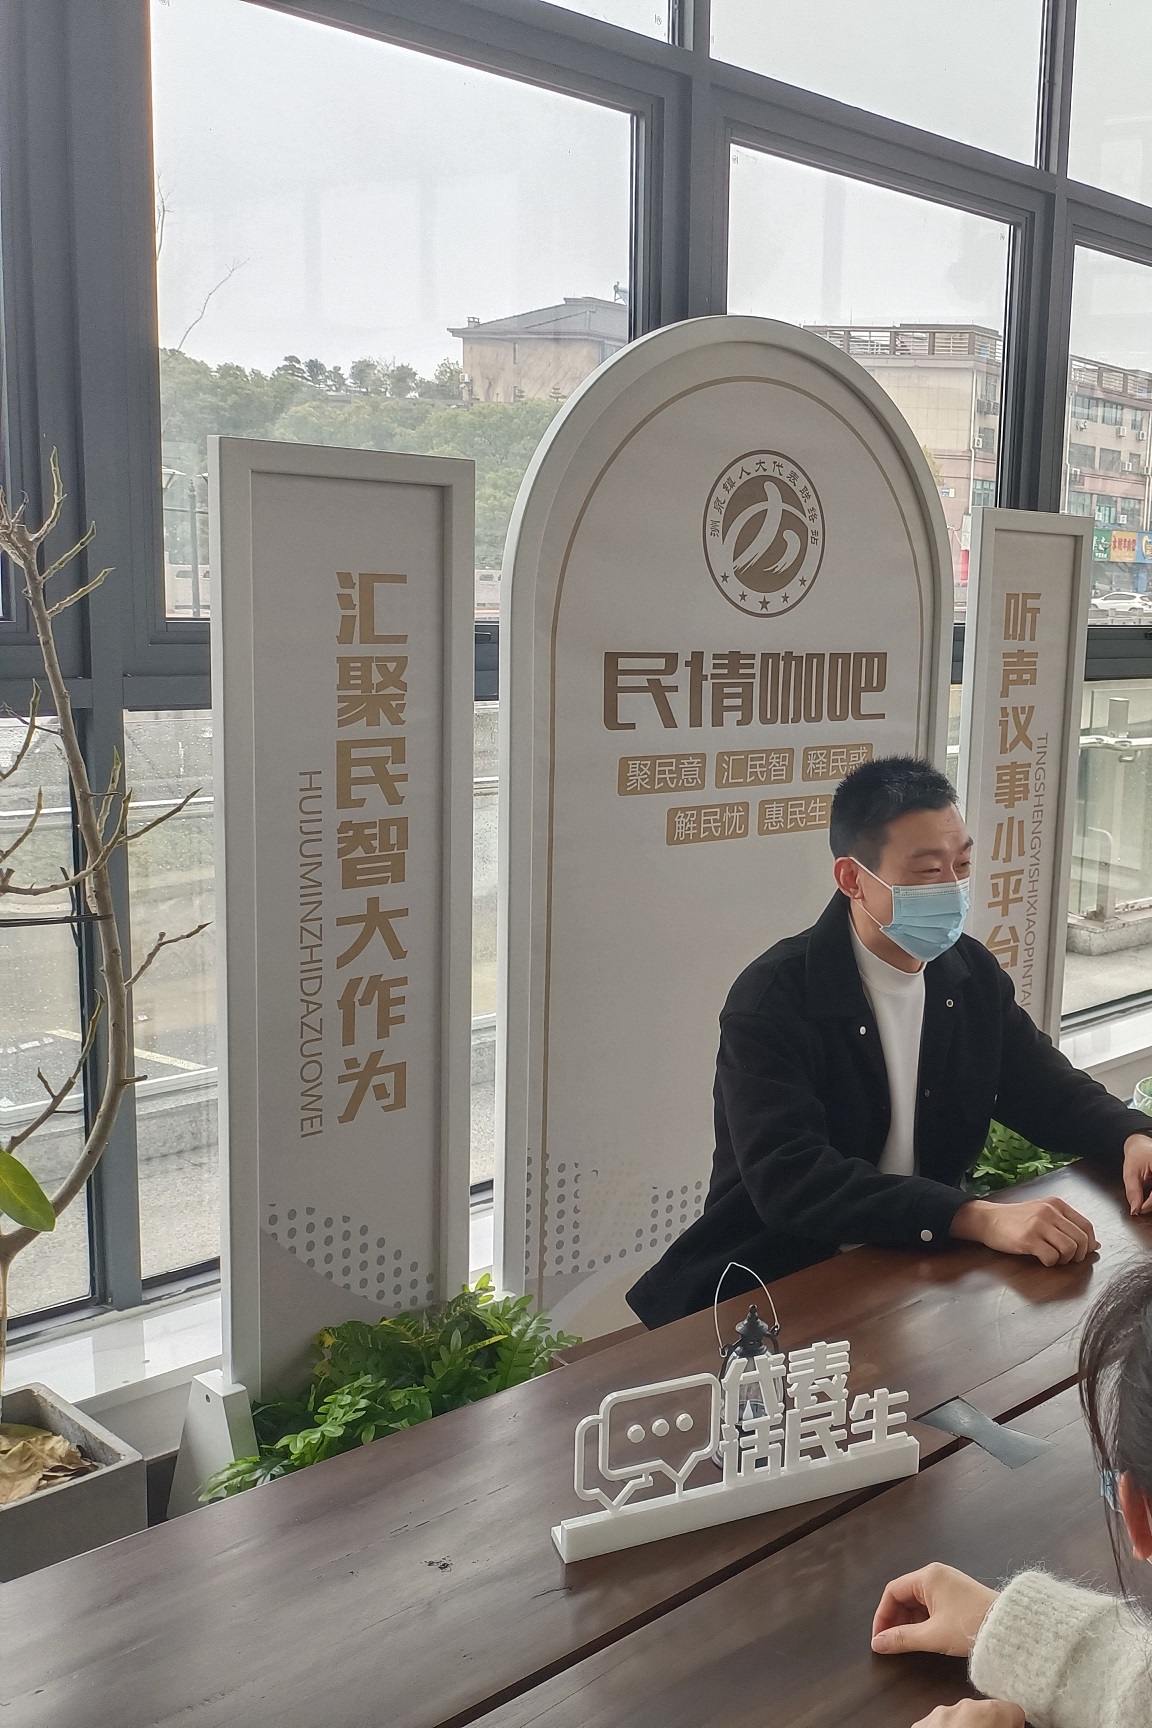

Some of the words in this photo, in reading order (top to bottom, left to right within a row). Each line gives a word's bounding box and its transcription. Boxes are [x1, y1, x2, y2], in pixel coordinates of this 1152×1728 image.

[709, 459, 820, 546] 洲泉镇人大代表联络站
[603, 650, 888, 731] 民情咖吧
[625, 756, 703, 792] 聚民意
[722, 751, 789, 786] 汇民智
[985, 592, 1042, 968] 听声议事小平台
[336, 571, 409, 1124] 汇聚民智大作为
[673, 805, 745, 842] 解民忧
[763, 798, 828, 831] 惠民生
[298, 770, 323, 1138] HUIJUMINZHIDAZUOWEI
[721, 1341, 850, 1422] 代表
[720, 1388, 910, 1481] 话民生
